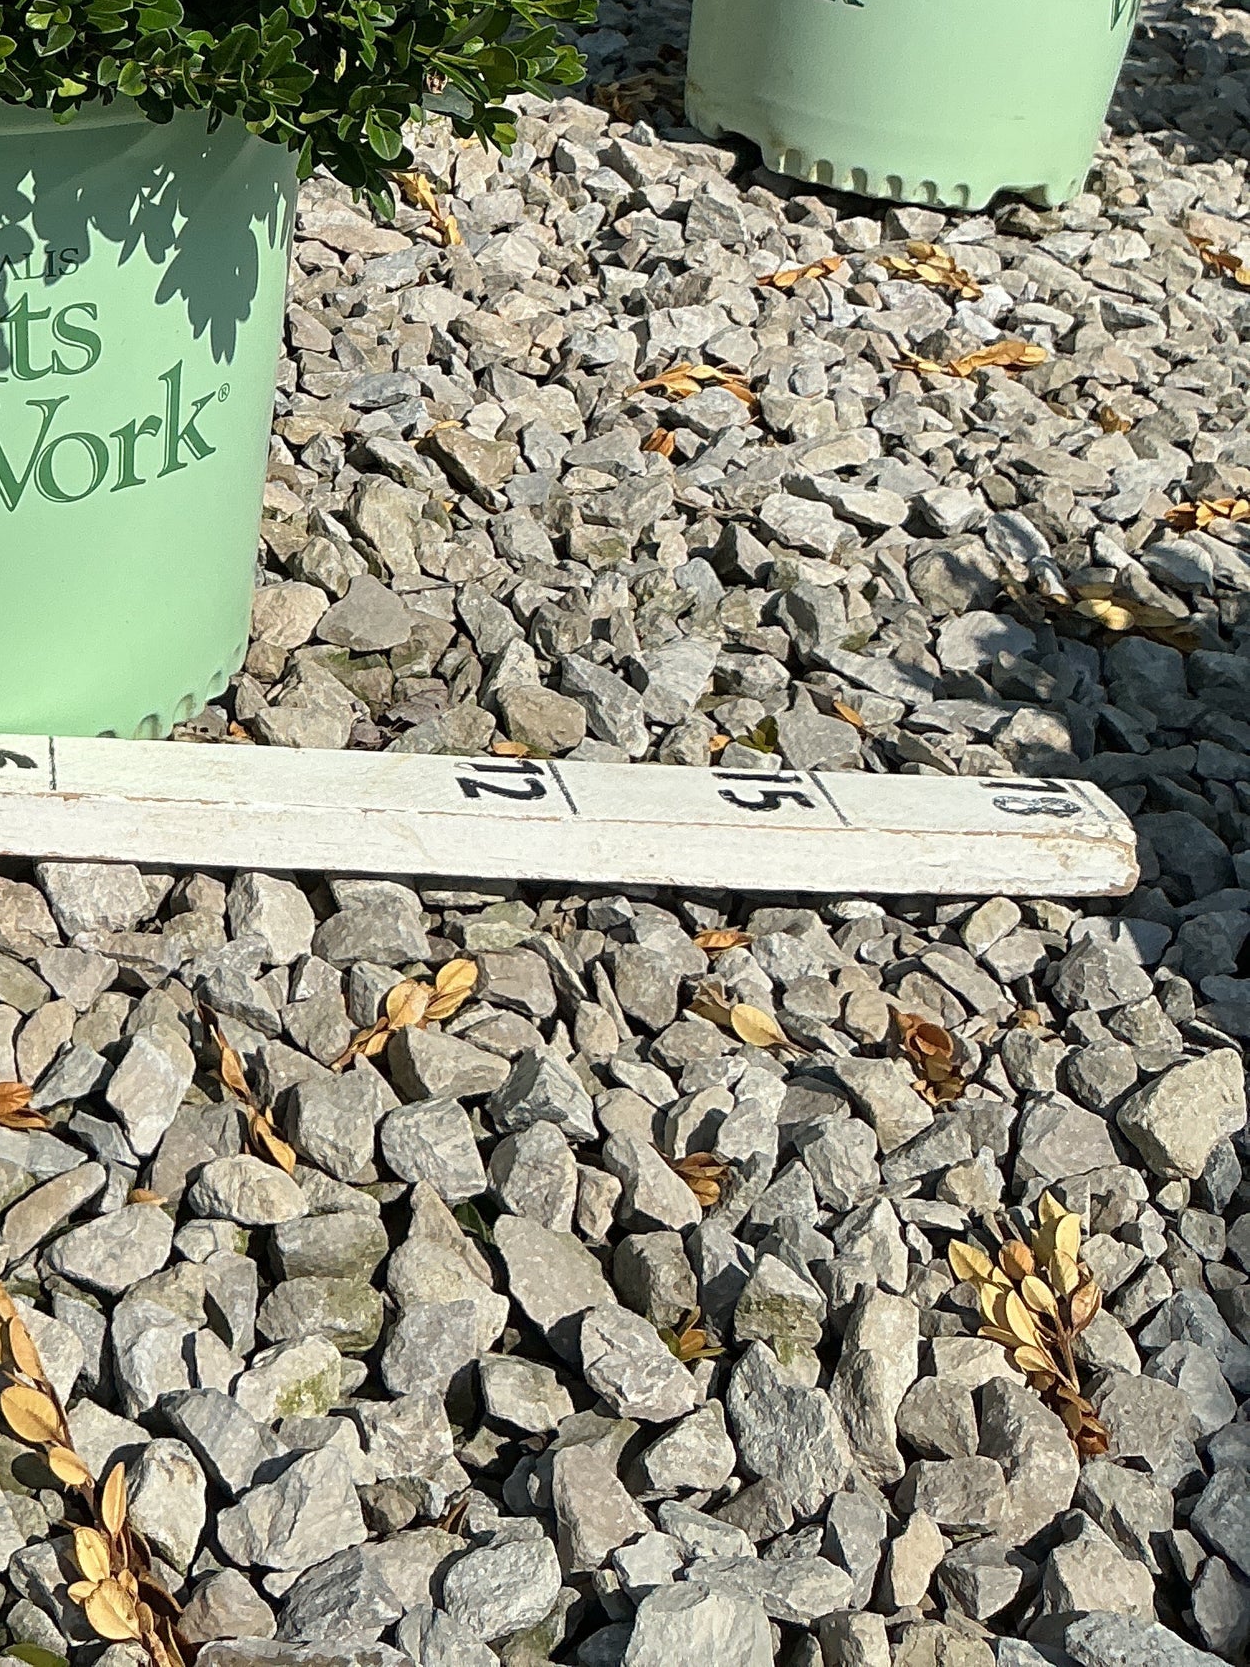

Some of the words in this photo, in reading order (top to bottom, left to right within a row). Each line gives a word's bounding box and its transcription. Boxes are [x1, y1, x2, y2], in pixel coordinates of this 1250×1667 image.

[454, 759, 547, 800] 12
[711, 771, 816, 812] 15
[978, 779, 1082, 818] 18
